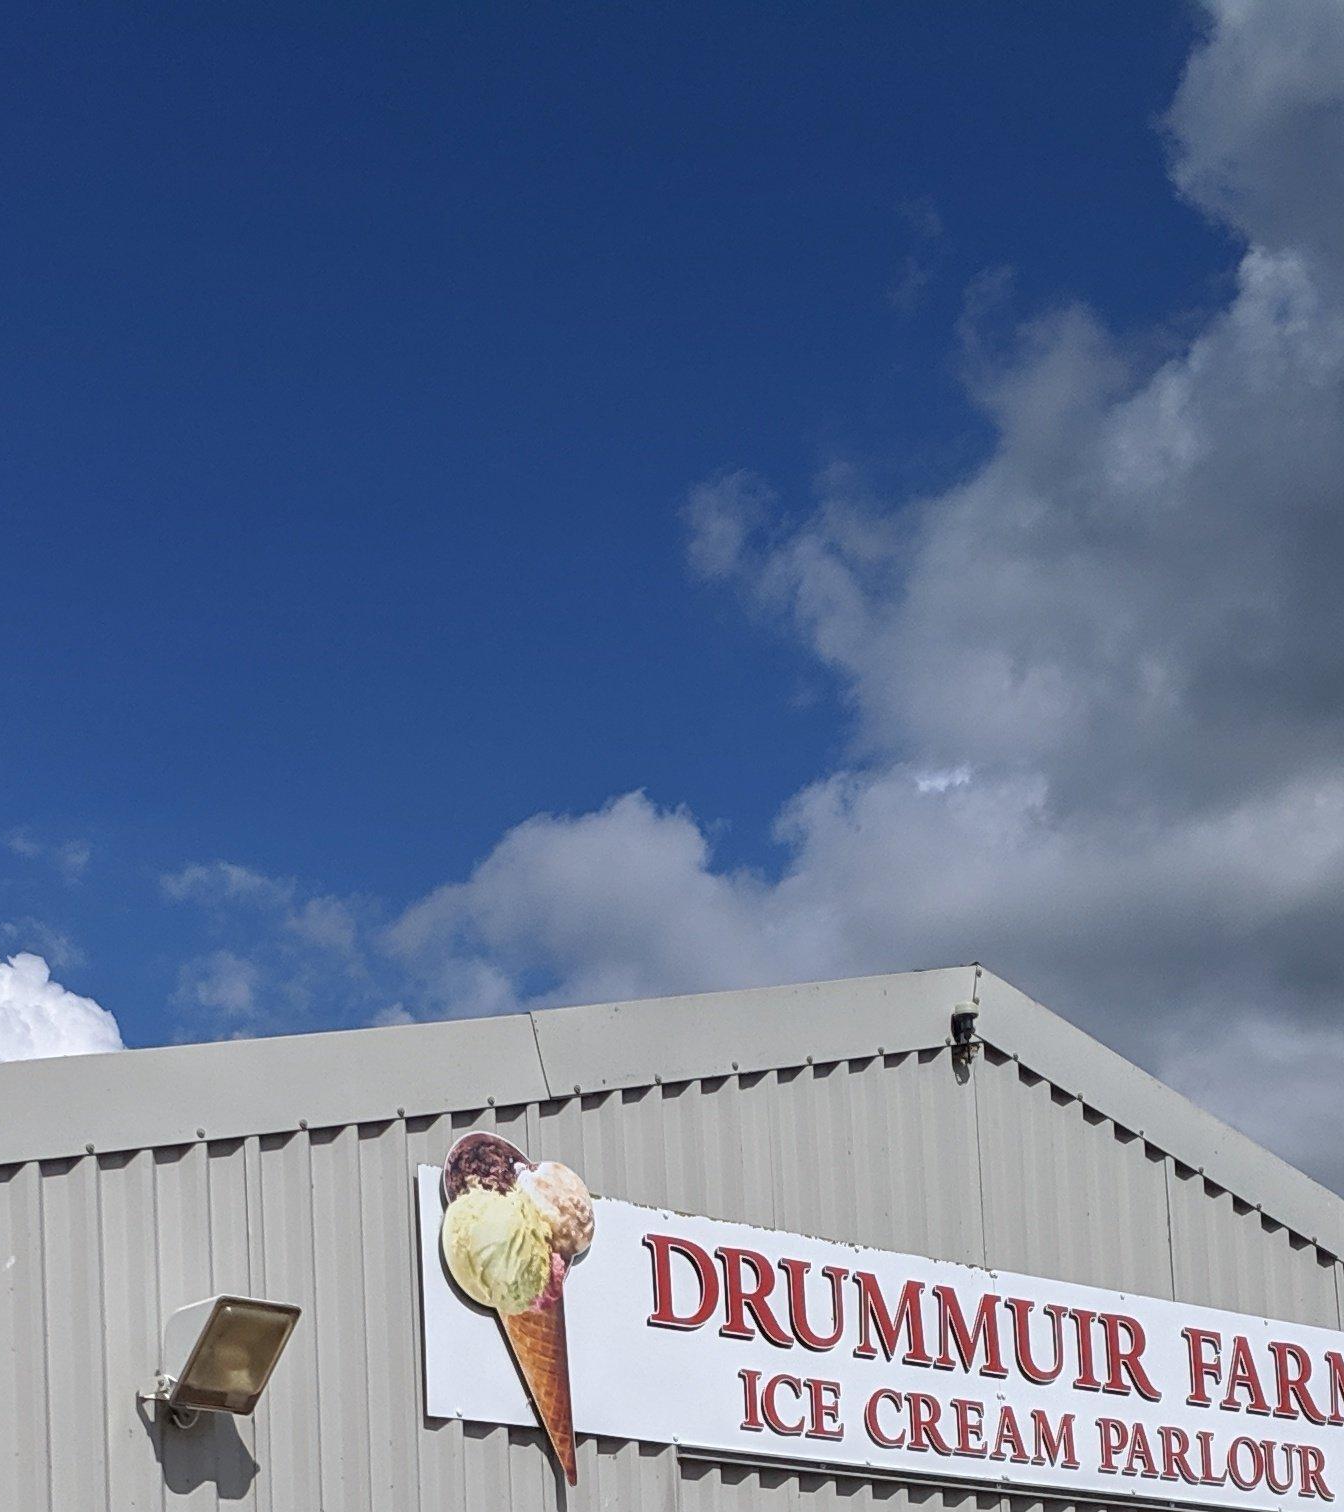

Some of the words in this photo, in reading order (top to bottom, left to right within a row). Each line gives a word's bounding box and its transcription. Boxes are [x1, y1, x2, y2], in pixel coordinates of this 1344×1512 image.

[643, 1234, 1162, 1401] DRUMMUIR
[737, 1369, 847, 1441] ICE
[865, 1388, 1080, 1469] CREAM
[1098, 1417, 1335, 1501] PARLOUR
